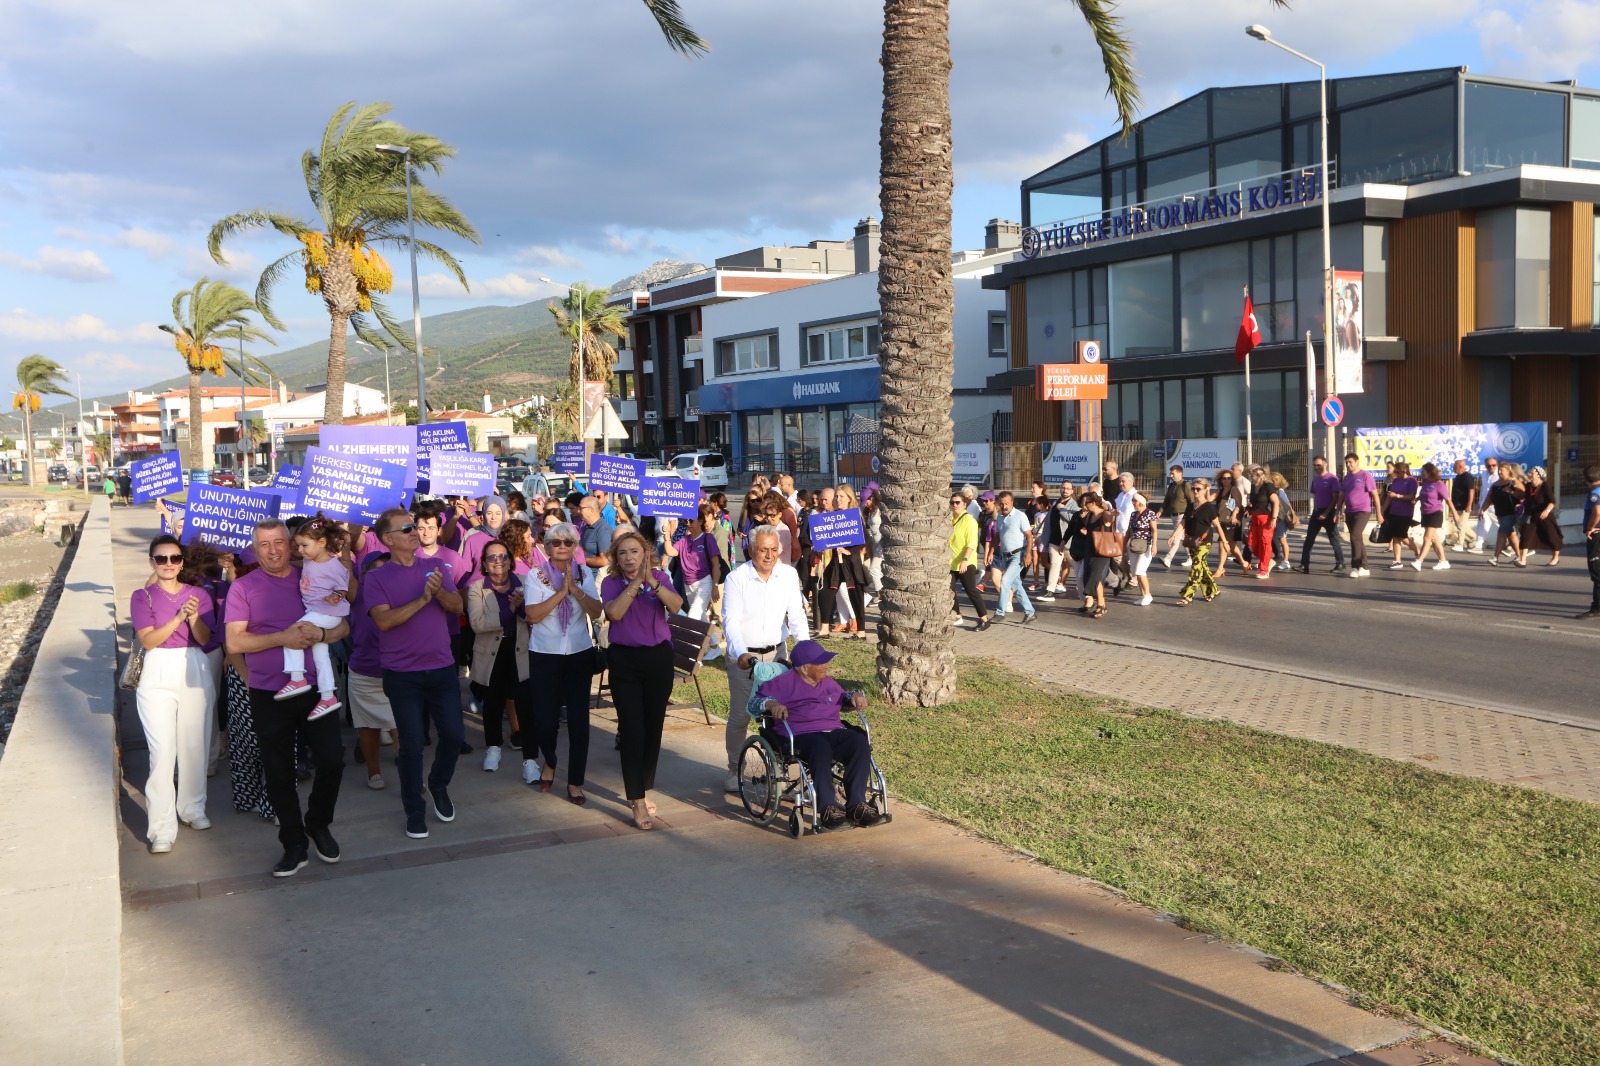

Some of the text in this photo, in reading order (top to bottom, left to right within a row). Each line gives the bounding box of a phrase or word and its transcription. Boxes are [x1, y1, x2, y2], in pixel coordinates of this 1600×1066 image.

[1042, 219, 1108, 250] YÜKSEK
[1112, 190, 1242, 238] PERFORMANS
[1047, 374, 1105, 384] PERFORMANS
[802, 382, 840, 396] HALKBANK
[1047, 385, 1077, 398] KOLEJİ
[313, 454, 352, 469] HERKES
[353, 462, 382, 476] UZUN
[600, 460, 634, 471] HİÇ AKLINA
[311, 465, 392, 489] YAŞAMAK İSTER
[308, 476, 331, 488] AMA
[332, 479, 365, 495] KİMSE
[656, 481, 671, 490] YAŞ
[200, 489, 267, 509] UNUTMANIN
[307, 486, 370, 507] YAŞLANMAK
[668, 490, 695, 499] GİBİDİR
[304, 495, 350, 514] İSTEMEZ
[643, 498, 694, 508] SAKLANAMAZ
[190, 502, 272, 522] KARANLIĞIND
[192, 517, 217, 530] ONU
[814, 523, 834, 532] SEVGİ
[816, 528, 859, 540] SAKLANAMAZ
